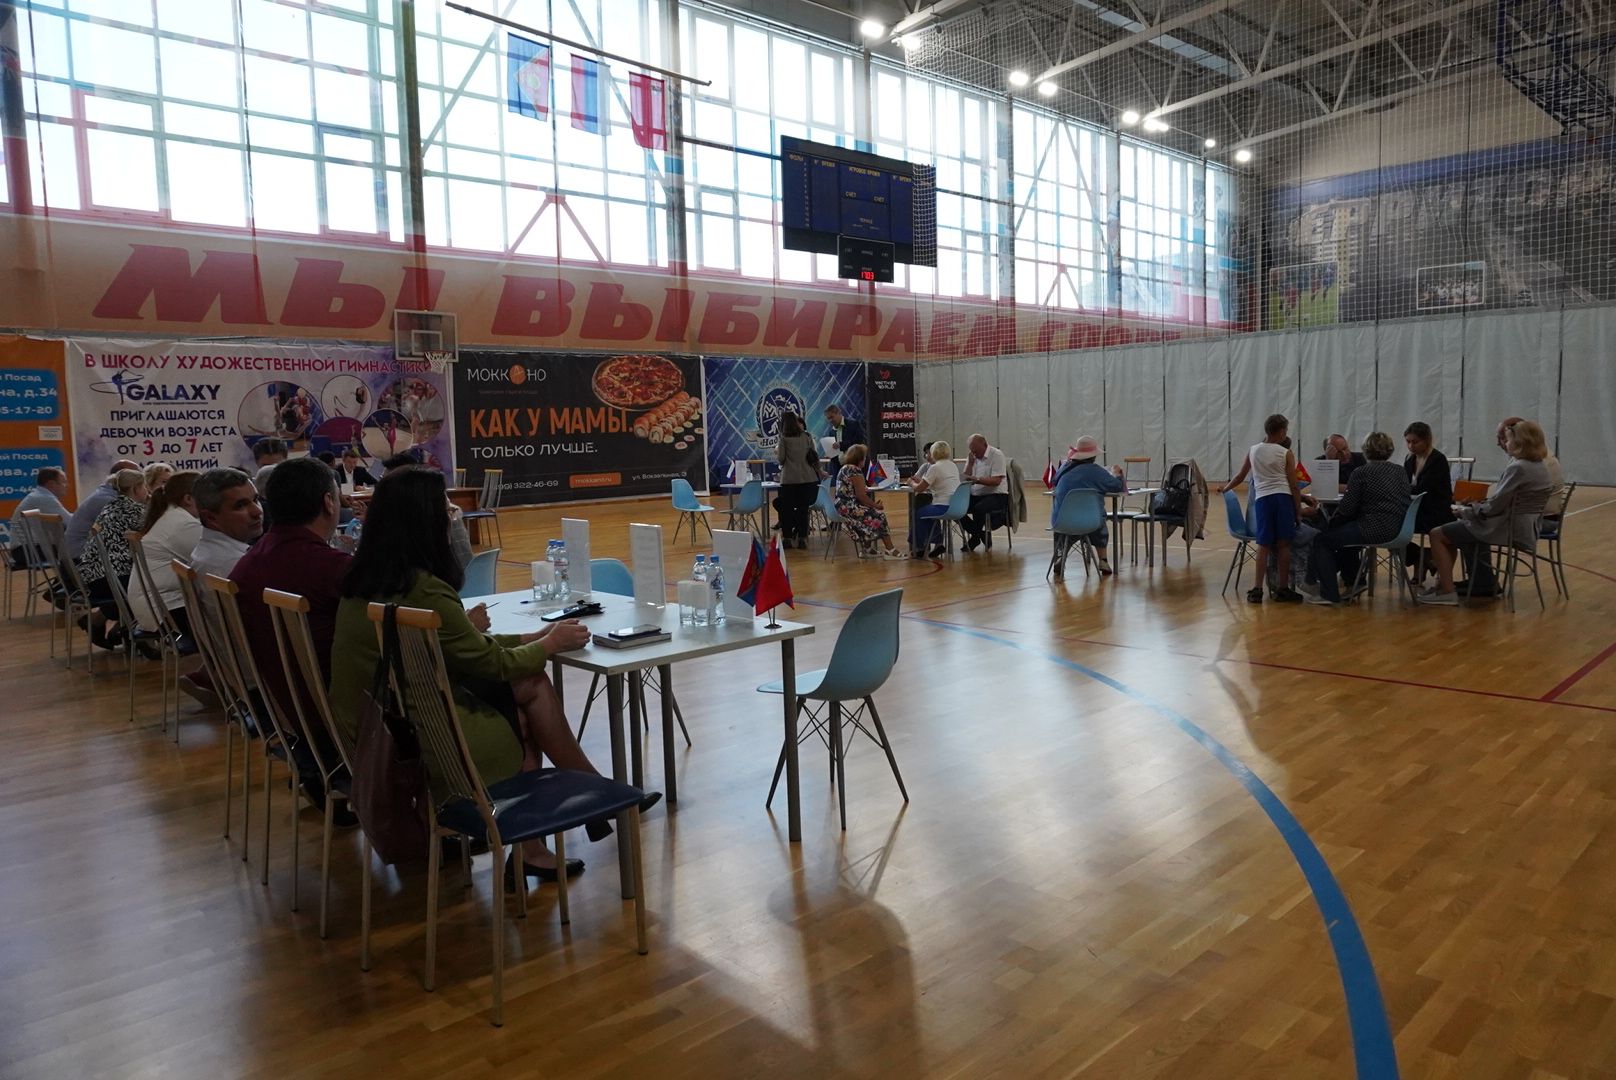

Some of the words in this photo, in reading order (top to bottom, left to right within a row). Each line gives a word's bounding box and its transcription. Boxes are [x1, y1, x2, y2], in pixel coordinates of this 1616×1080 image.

[92, 243, 445, 331] МЫ
[490, 274, 1016, 356] ВЫБИРАЕМ
[85, 353, 96, 368] В
[102, 354, 170, 369] ШКОЛУ
[176, 355, 335, 372] ХУДОЖЕСТВЕННОЙ
[5, 374, 42, 382] Посад
[126, 384, 221, 401] GALAXY
[0, 406, 53, 416] 5-17-20
[111, 409, 225, 421] ПРИГЛАШАЮТСЯ
[470, 408, 522, 438] КАК
[527, 408, 541, 435] У
[550, 406, 634, 434] МАМЫ.
[891, 421, 914, 429] ПАРКЕ
[100, 428, 165, 438] ДЕВОЧКИ
[168, 426, 237, 437] ВОЗРАСТА
[117, 444, 137, 455] ОТ
[143, 439, 155, 456] 3
[160, 443, 181, 453] ДО
[185, 438, 197, 454] 7
[200, 442, 223, 452] ЛЕТ
[471, 445, 534, 459] ТОЛЬКО
[540, 442, 598, 455] ЛУЧШЕ.
[514, 480, 559, 489] 322-46-69
